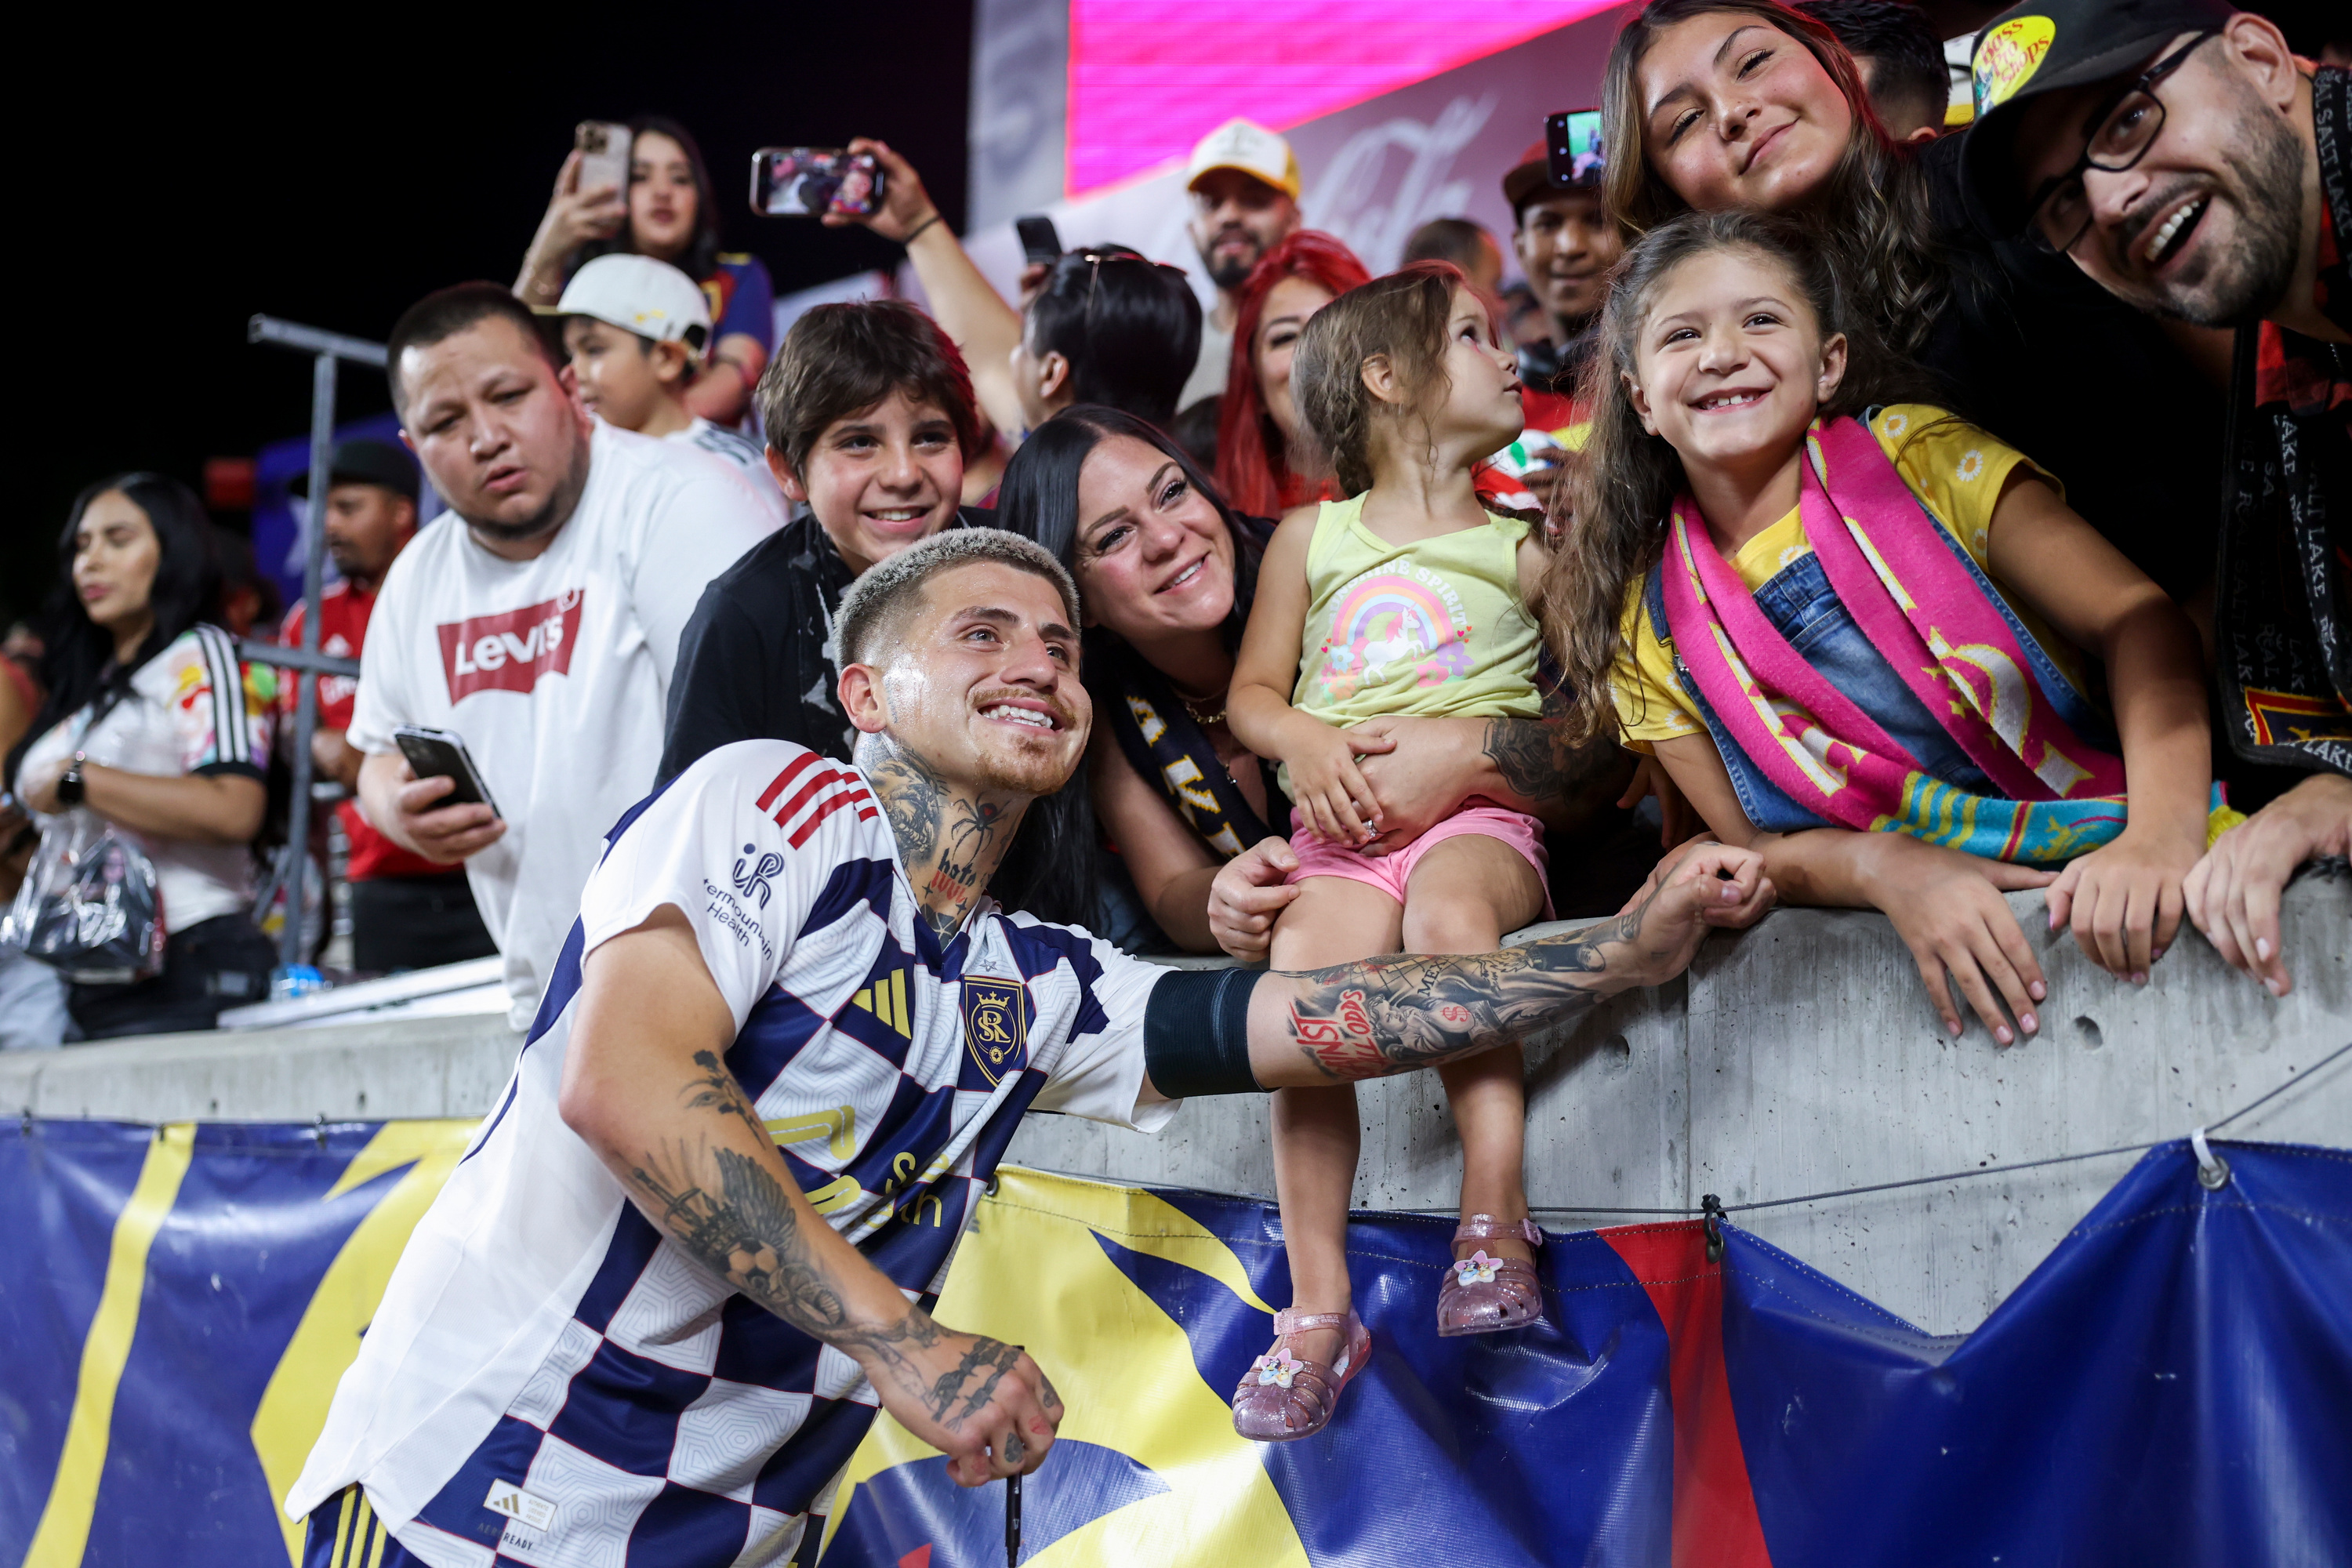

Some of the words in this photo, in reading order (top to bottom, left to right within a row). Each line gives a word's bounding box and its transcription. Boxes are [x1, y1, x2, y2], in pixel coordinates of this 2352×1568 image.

[1980, 20, 2023, 65] Bass
[1991, 41, 2018, 77] Pro
[2002, 35, 2049, 82] Shops
[2281, 414, 2299, 476] AKE
[1415, 567, 1468, 626] SPIRIT
[2308, 525, 2326, 598] LAKE
[2320, 615, 2334, 672] REA
[2232, 630, 2252, 693] LAK
[707, 902, 750, 947] Health
[477, 1523, 534, 1551] AERREADY
